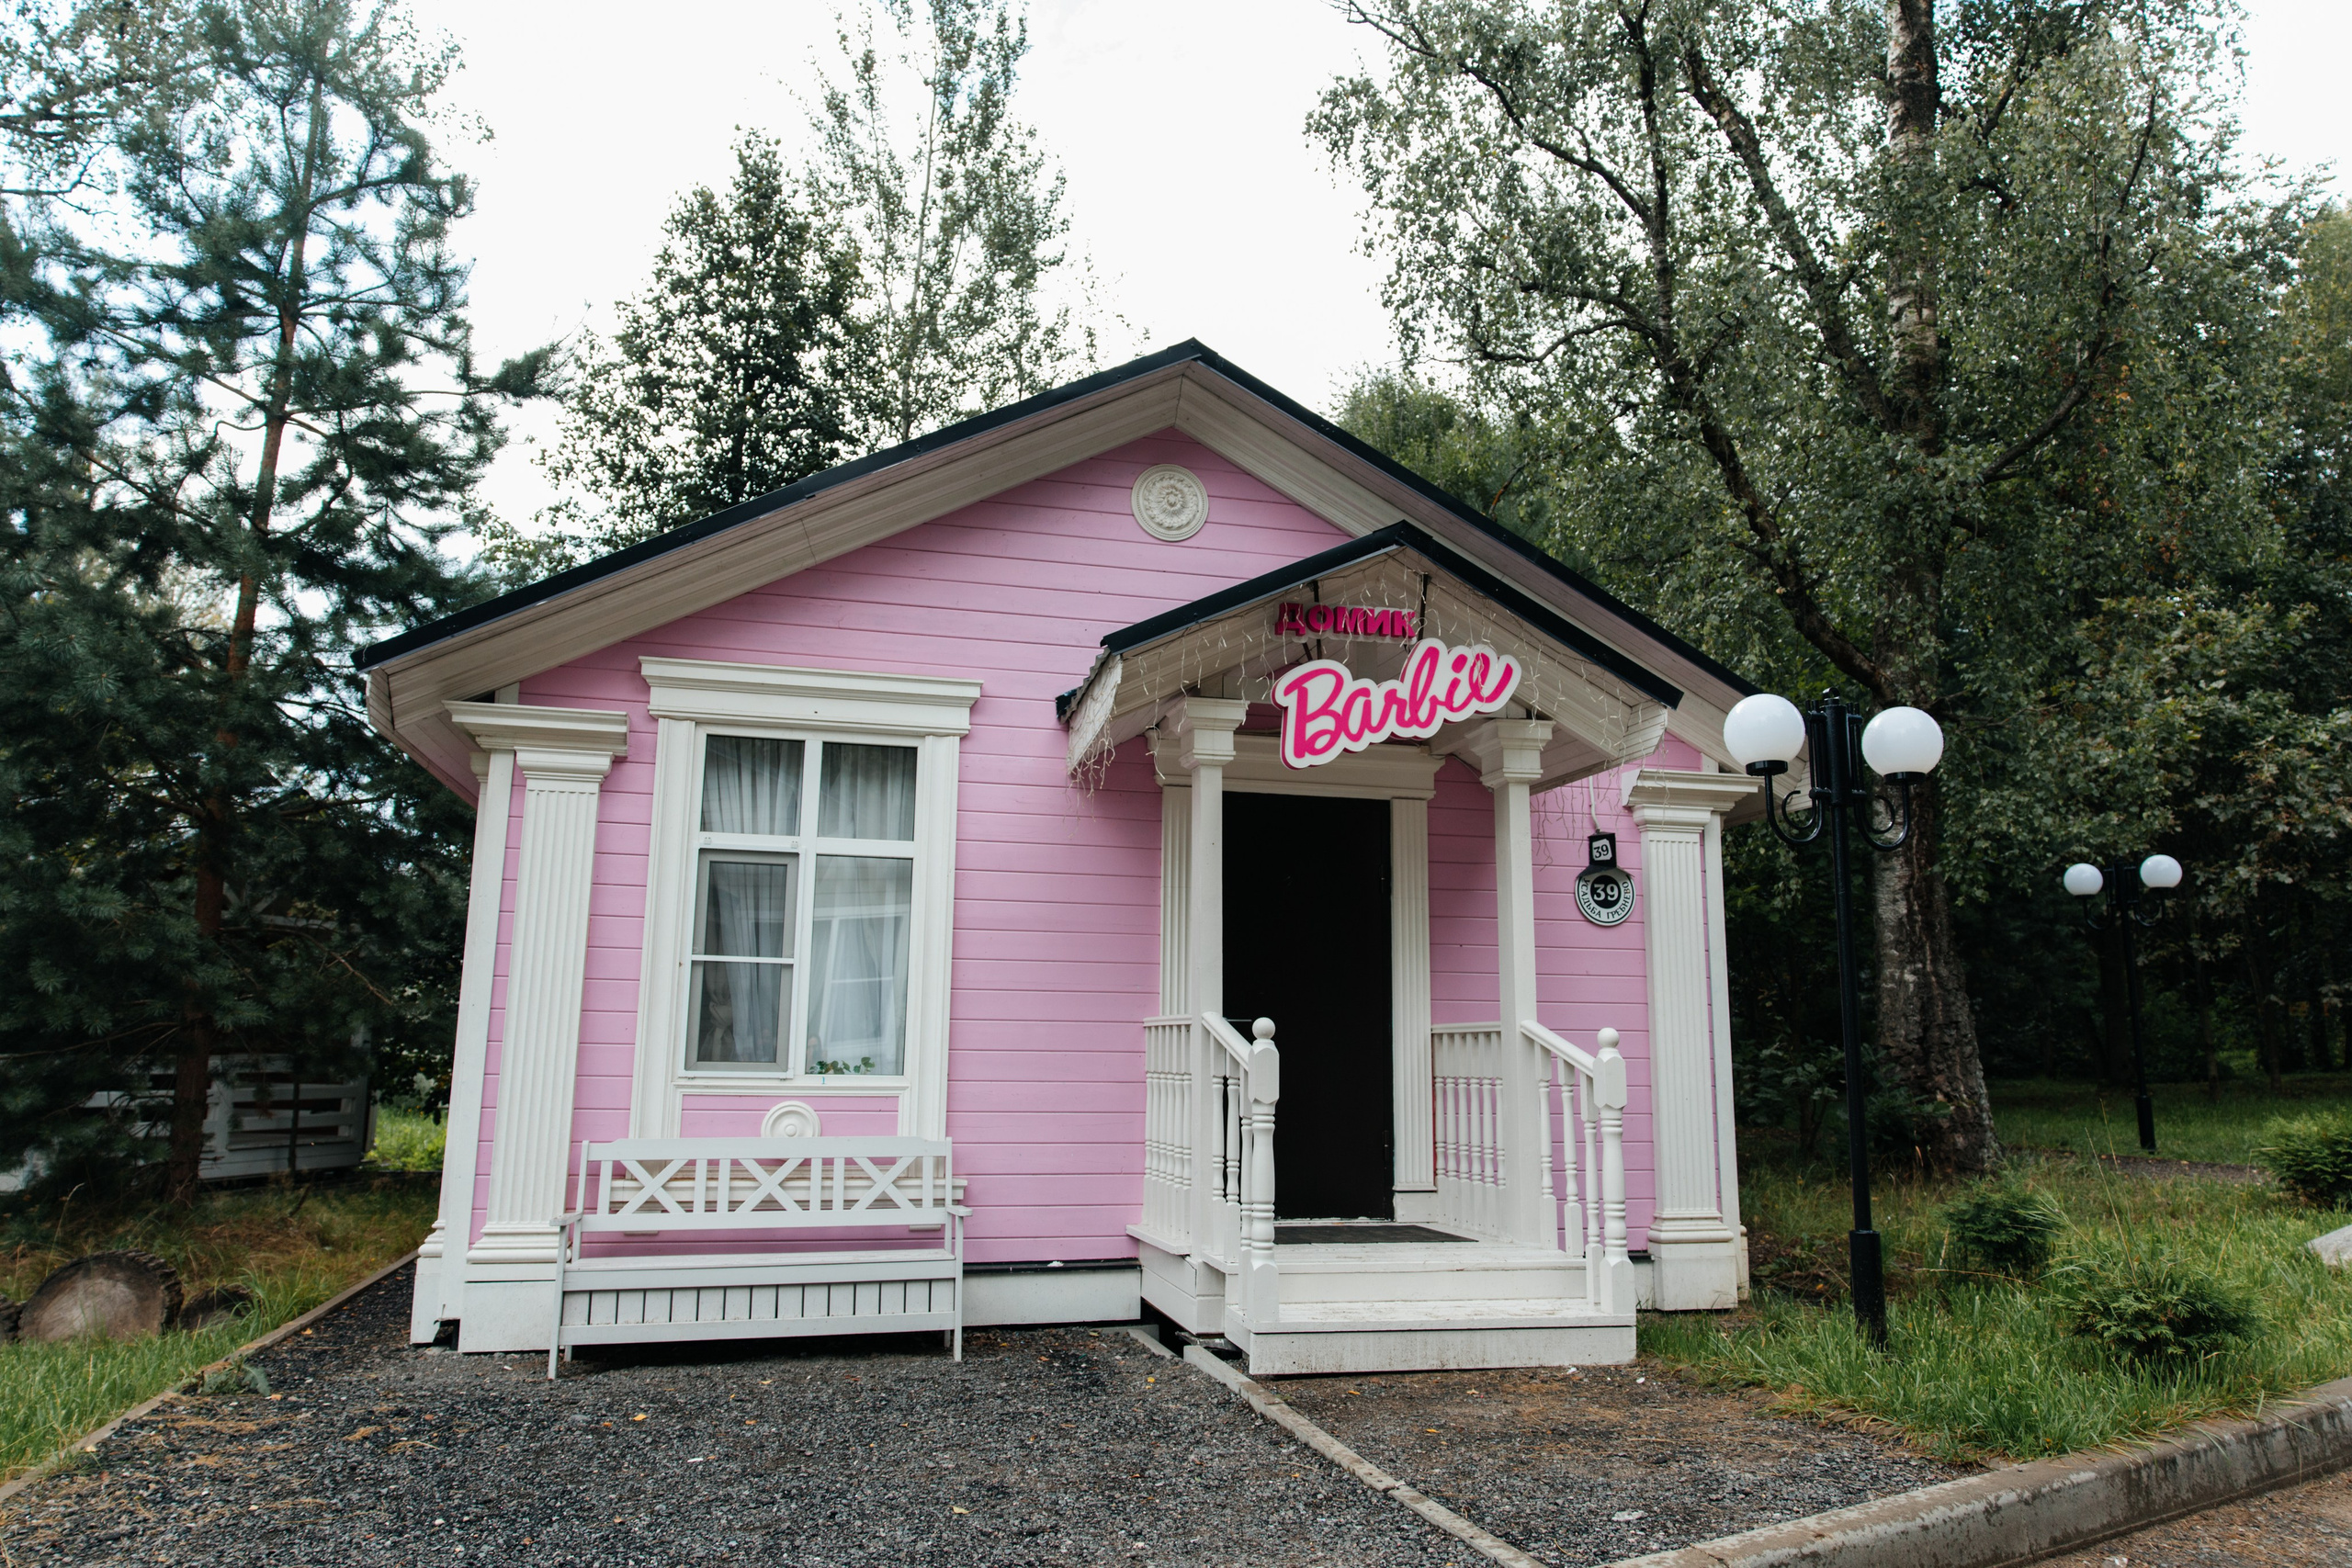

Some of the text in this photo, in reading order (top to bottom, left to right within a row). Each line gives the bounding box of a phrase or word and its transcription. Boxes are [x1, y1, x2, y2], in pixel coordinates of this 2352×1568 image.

[1275, 603, 1416, 637] ДОМИК
[1283, 646, 1513, 759] Barbie
[1593, 844, 1609, 858] 39
[1581, 878, 1631, 919] УСАДЬБА ГРЕБНЕВО
[1593, 884, 1619, 901] 39
